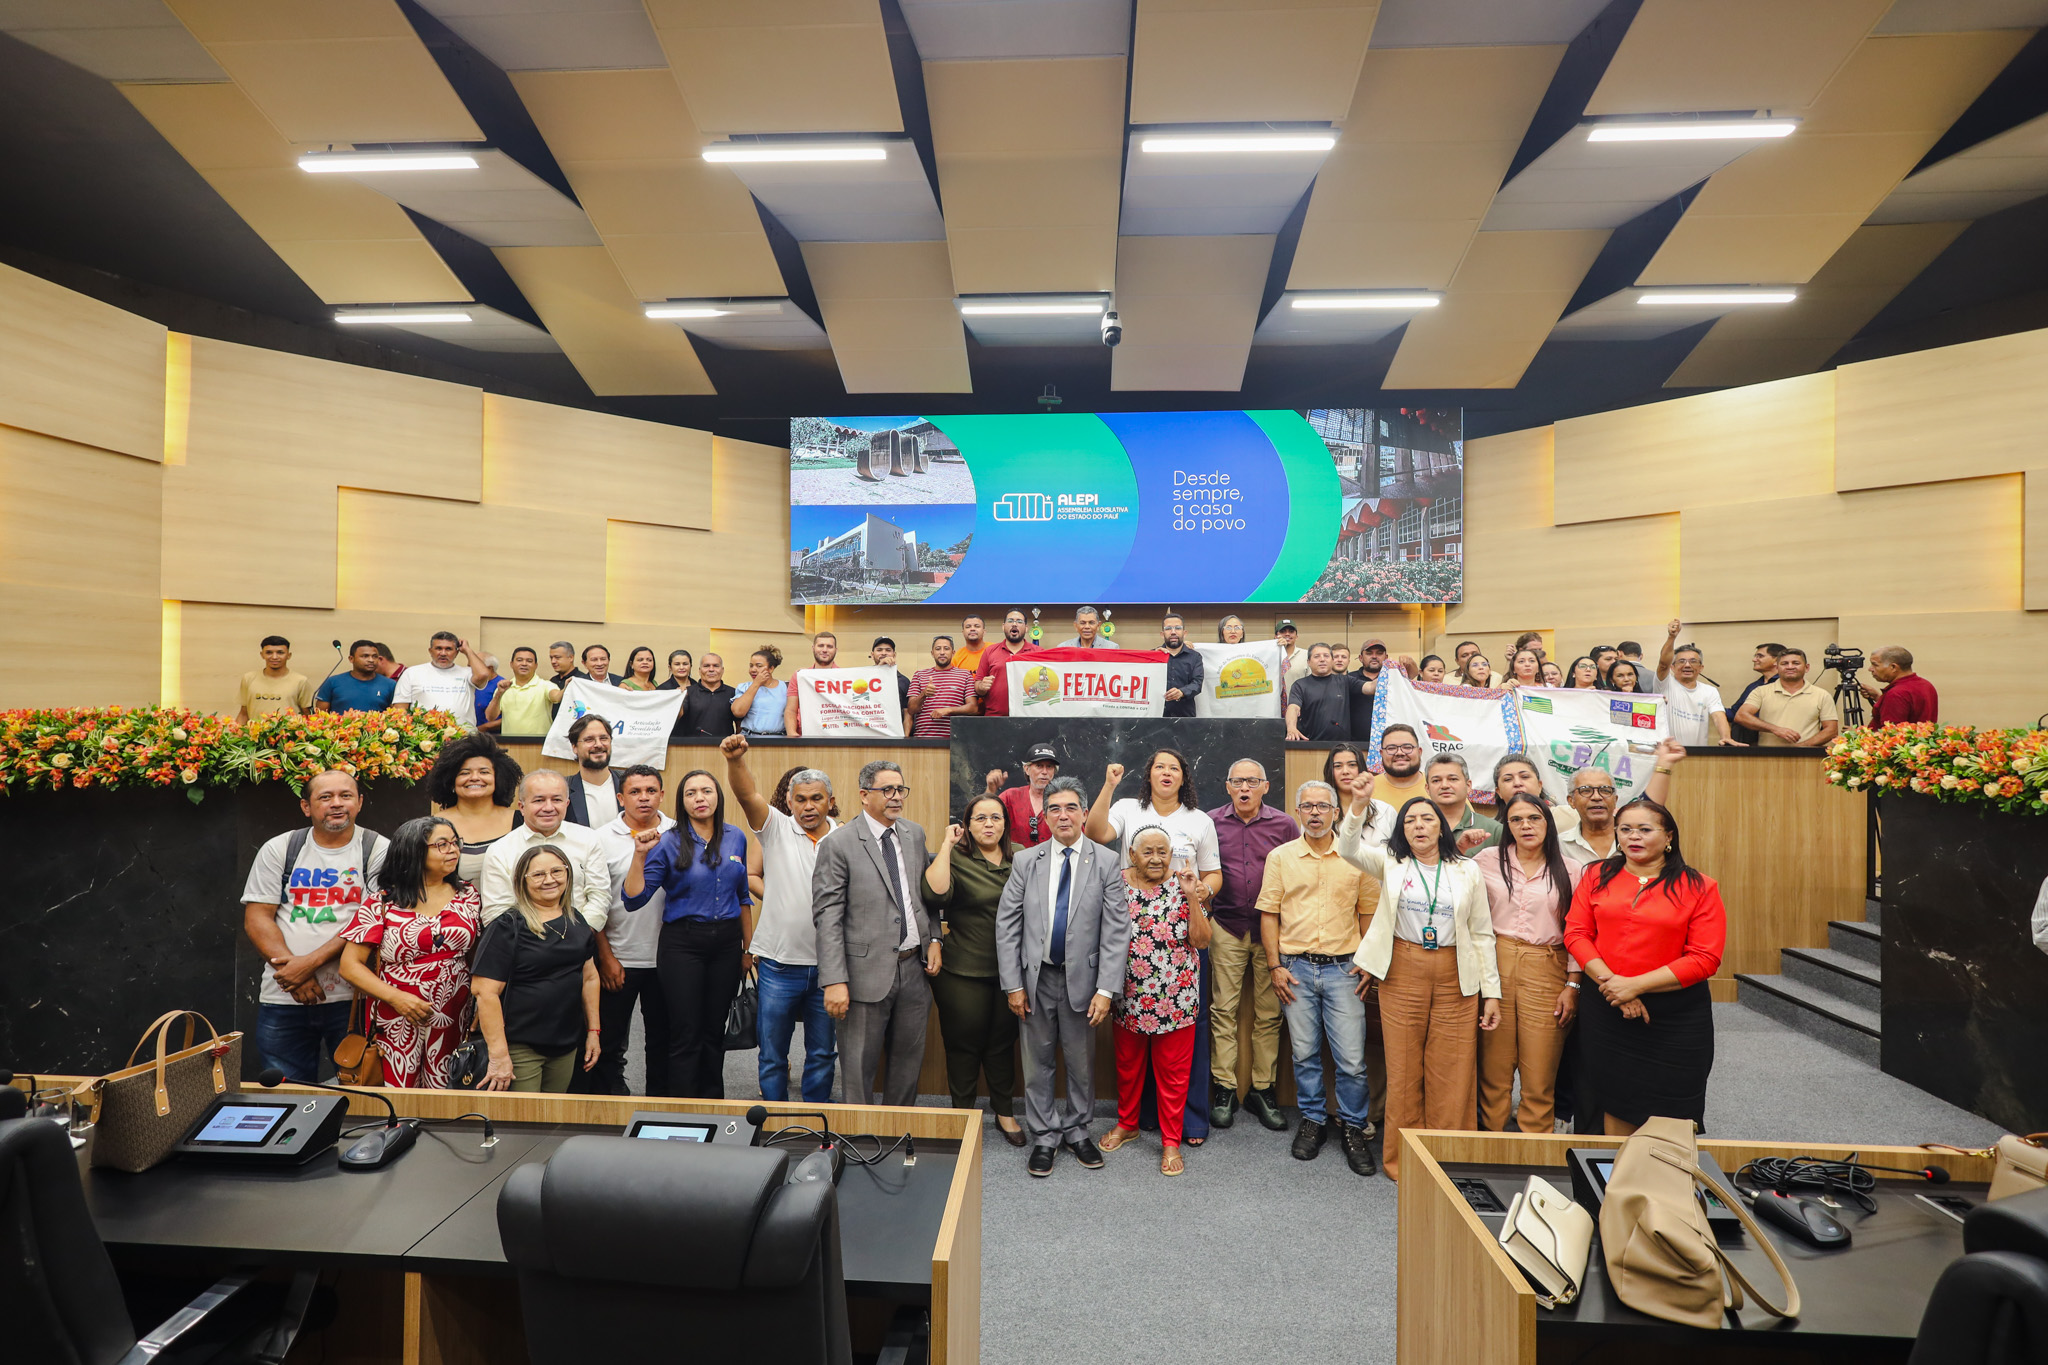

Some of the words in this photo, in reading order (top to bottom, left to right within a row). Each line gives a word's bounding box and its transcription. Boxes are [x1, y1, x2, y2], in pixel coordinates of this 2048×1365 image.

[1174, 470, 1230, 486] Desde
[1057, 494, 1099, 506] ALEPI
[1172, 488, 1244, 504] sempre,
[1172, 504, 1184, 516] a
[1190, 504, 1232, 516] casa
[1172, 516, 1196, 530] do
[1202, 518, 1246, 534] povo
[1063, 672, 1150, 700] FETAG-PI
[1550, 739, 1632, 778] CEAA
[290, 868, 339, 887] RIS
[289, 886, 362, 907] TERA
[290, 906, 337, 924] PIA
